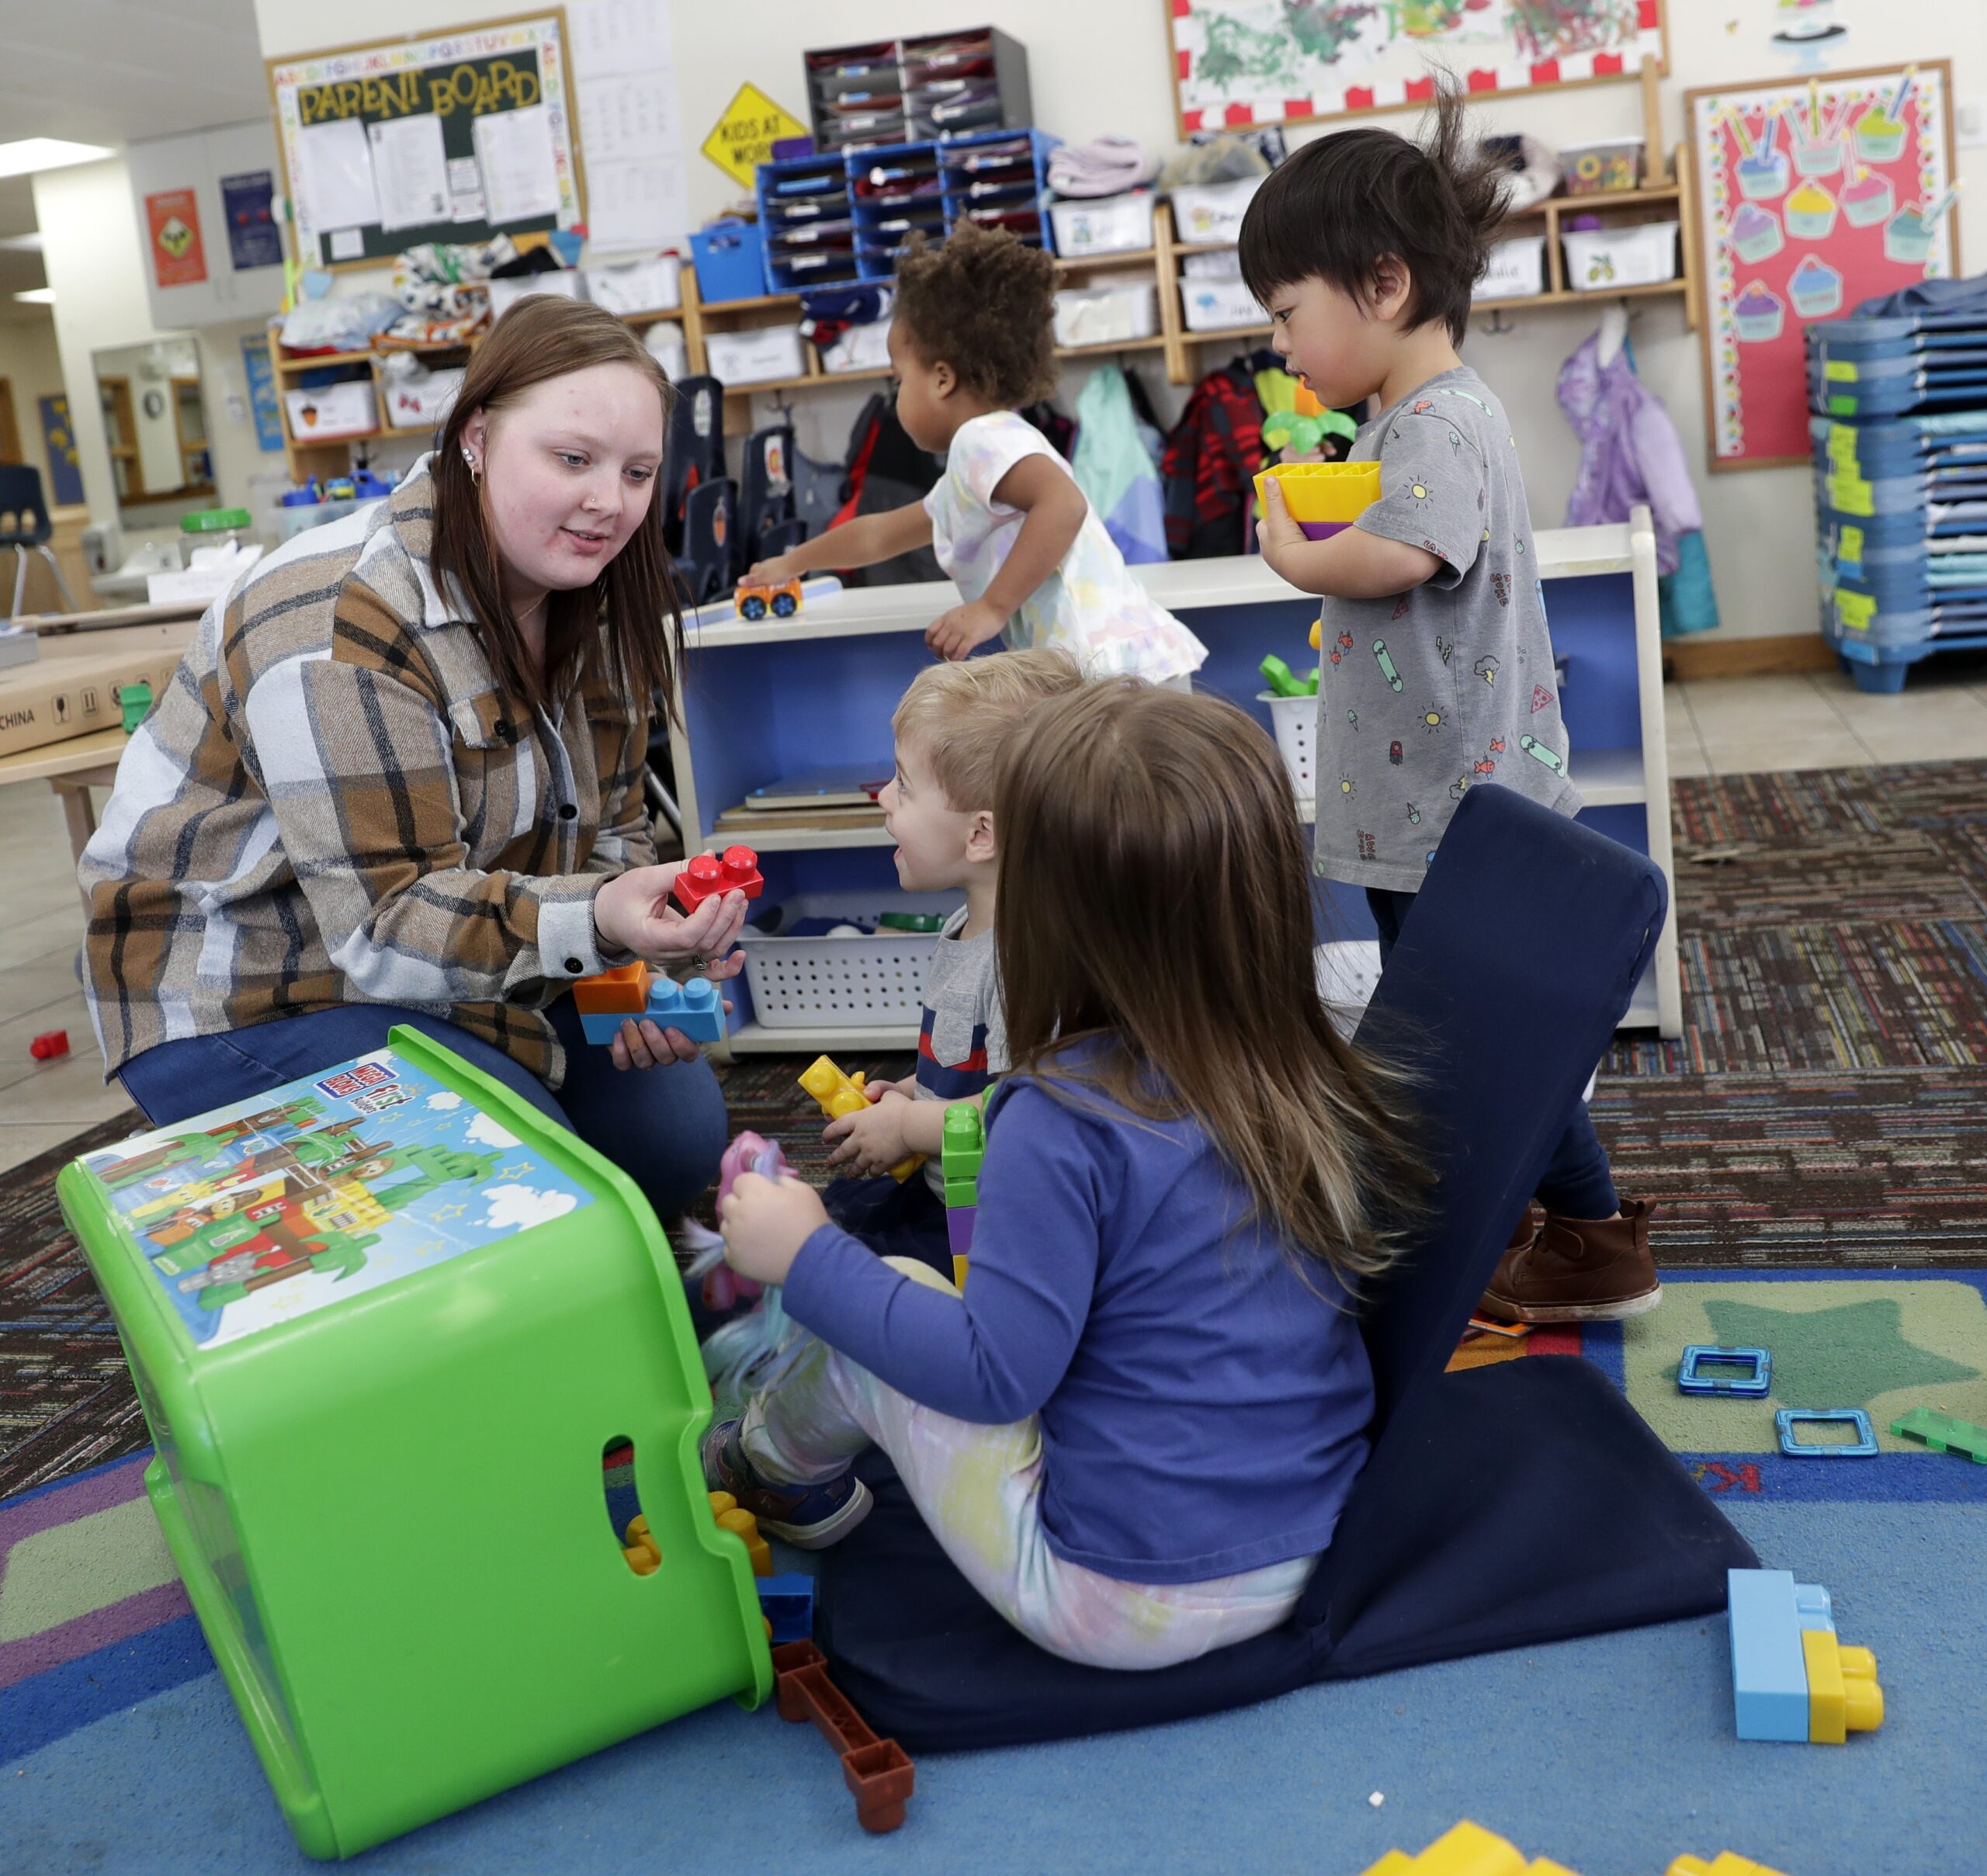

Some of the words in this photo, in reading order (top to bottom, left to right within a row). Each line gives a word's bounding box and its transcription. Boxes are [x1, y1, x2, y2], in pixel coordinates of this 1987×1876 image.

[299, 68, 425, 125] PARENT
[428, 60, 540, 116] BOARD
[720, 118, 759, 144] KIDS
[763, 113, 779, 135] AT
[732, 141, 772, 165] WOR
[0, 708, 36, 731] CHINA
[323, 1073, 364, 1096] BLOKS
[348, 1063, 389, 1087] MEGA
[365, 1083, 414, 1111] first
